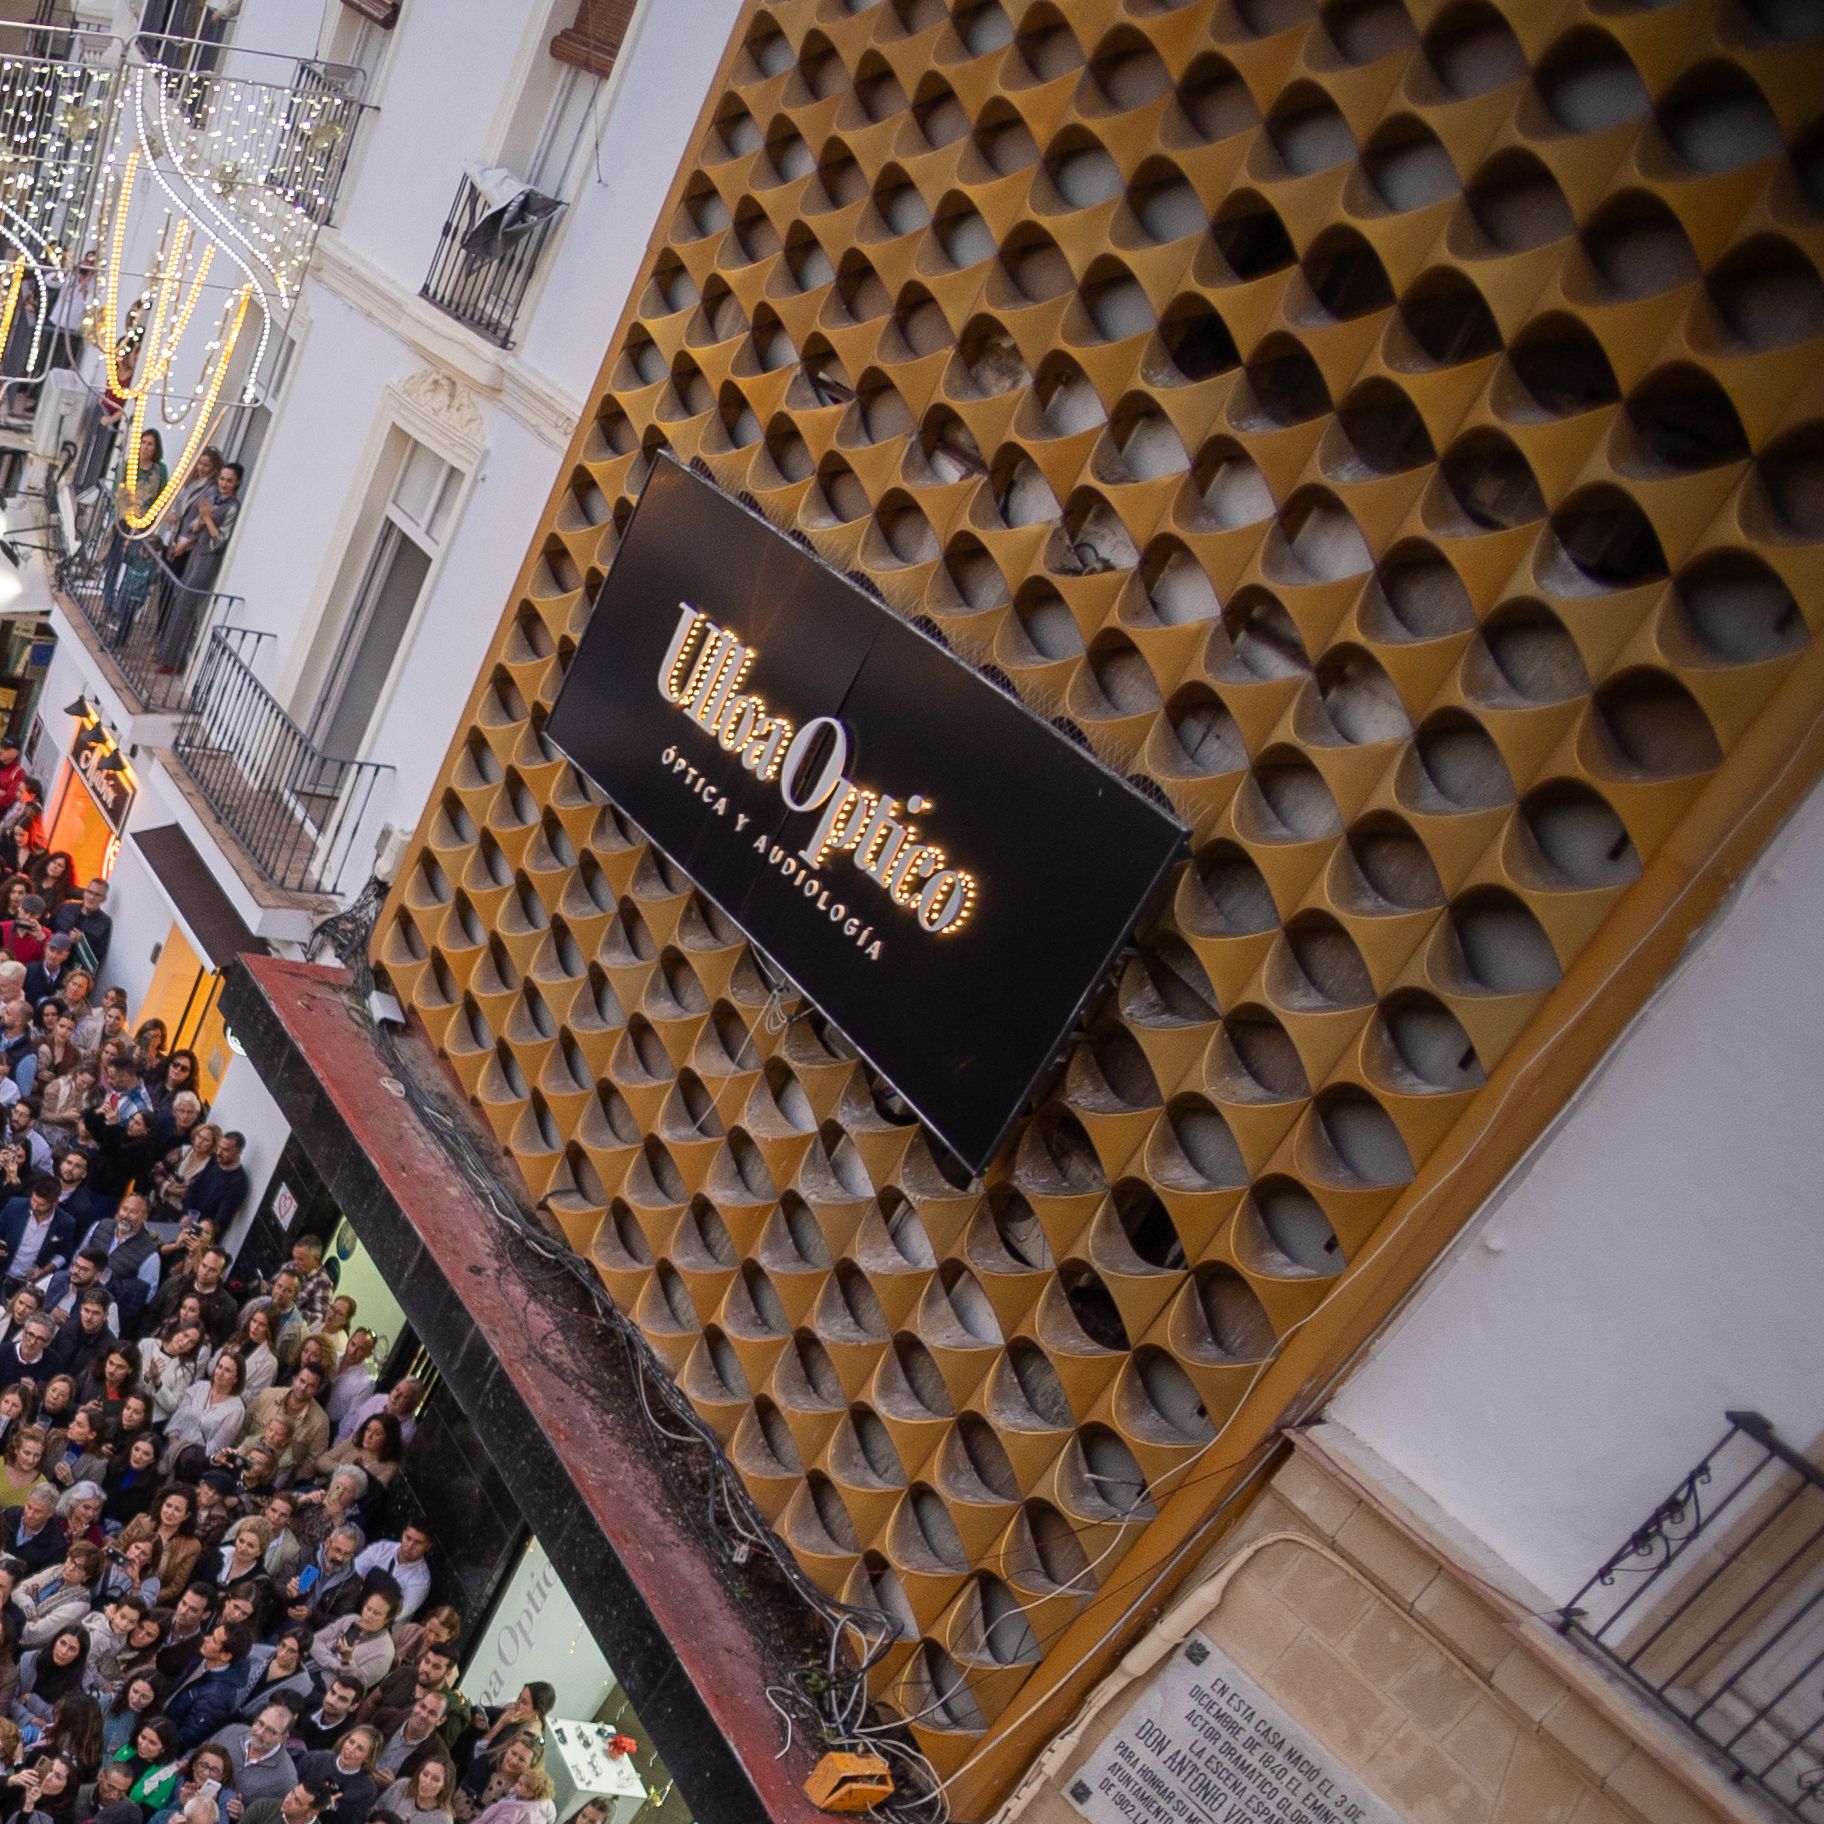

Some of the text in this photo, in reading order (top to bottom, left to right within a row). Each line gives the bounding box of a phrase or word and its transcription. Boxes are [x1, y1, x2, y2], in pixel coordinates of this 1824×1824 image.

[660, 745, 883, 961] ÓPTICA Y AUDIOLOGÍA
[1098, 1777, 1116, 1796] DE
[1114, 1740, 1140, 1769] PARA
[1137, 1763, 1176, 1804] HONRAR
[1172, 1799, 1190, 1818] SU
[1135, 1718, 1172, 1757] DON
[1162, 1749, 1228, 1812] ANTONIO
[1184, 1709, 1221, 1745] ACTOR
[1218, 1741, 1279, 1800] DRAMATICO
[1189, 1685, 1246, 1741] DICIEMBRE
[1242, 1736, 1263, 1756] DE
[1285, 1776, 1302, 1797] EL
[1189, 1739, 1207, 1759] LA
[1204, 1755, 1247, 1800] ESCENA
[1210, 1677, 1366, 1824] EN ESTA CASA NACIÓ EL 3 DE
